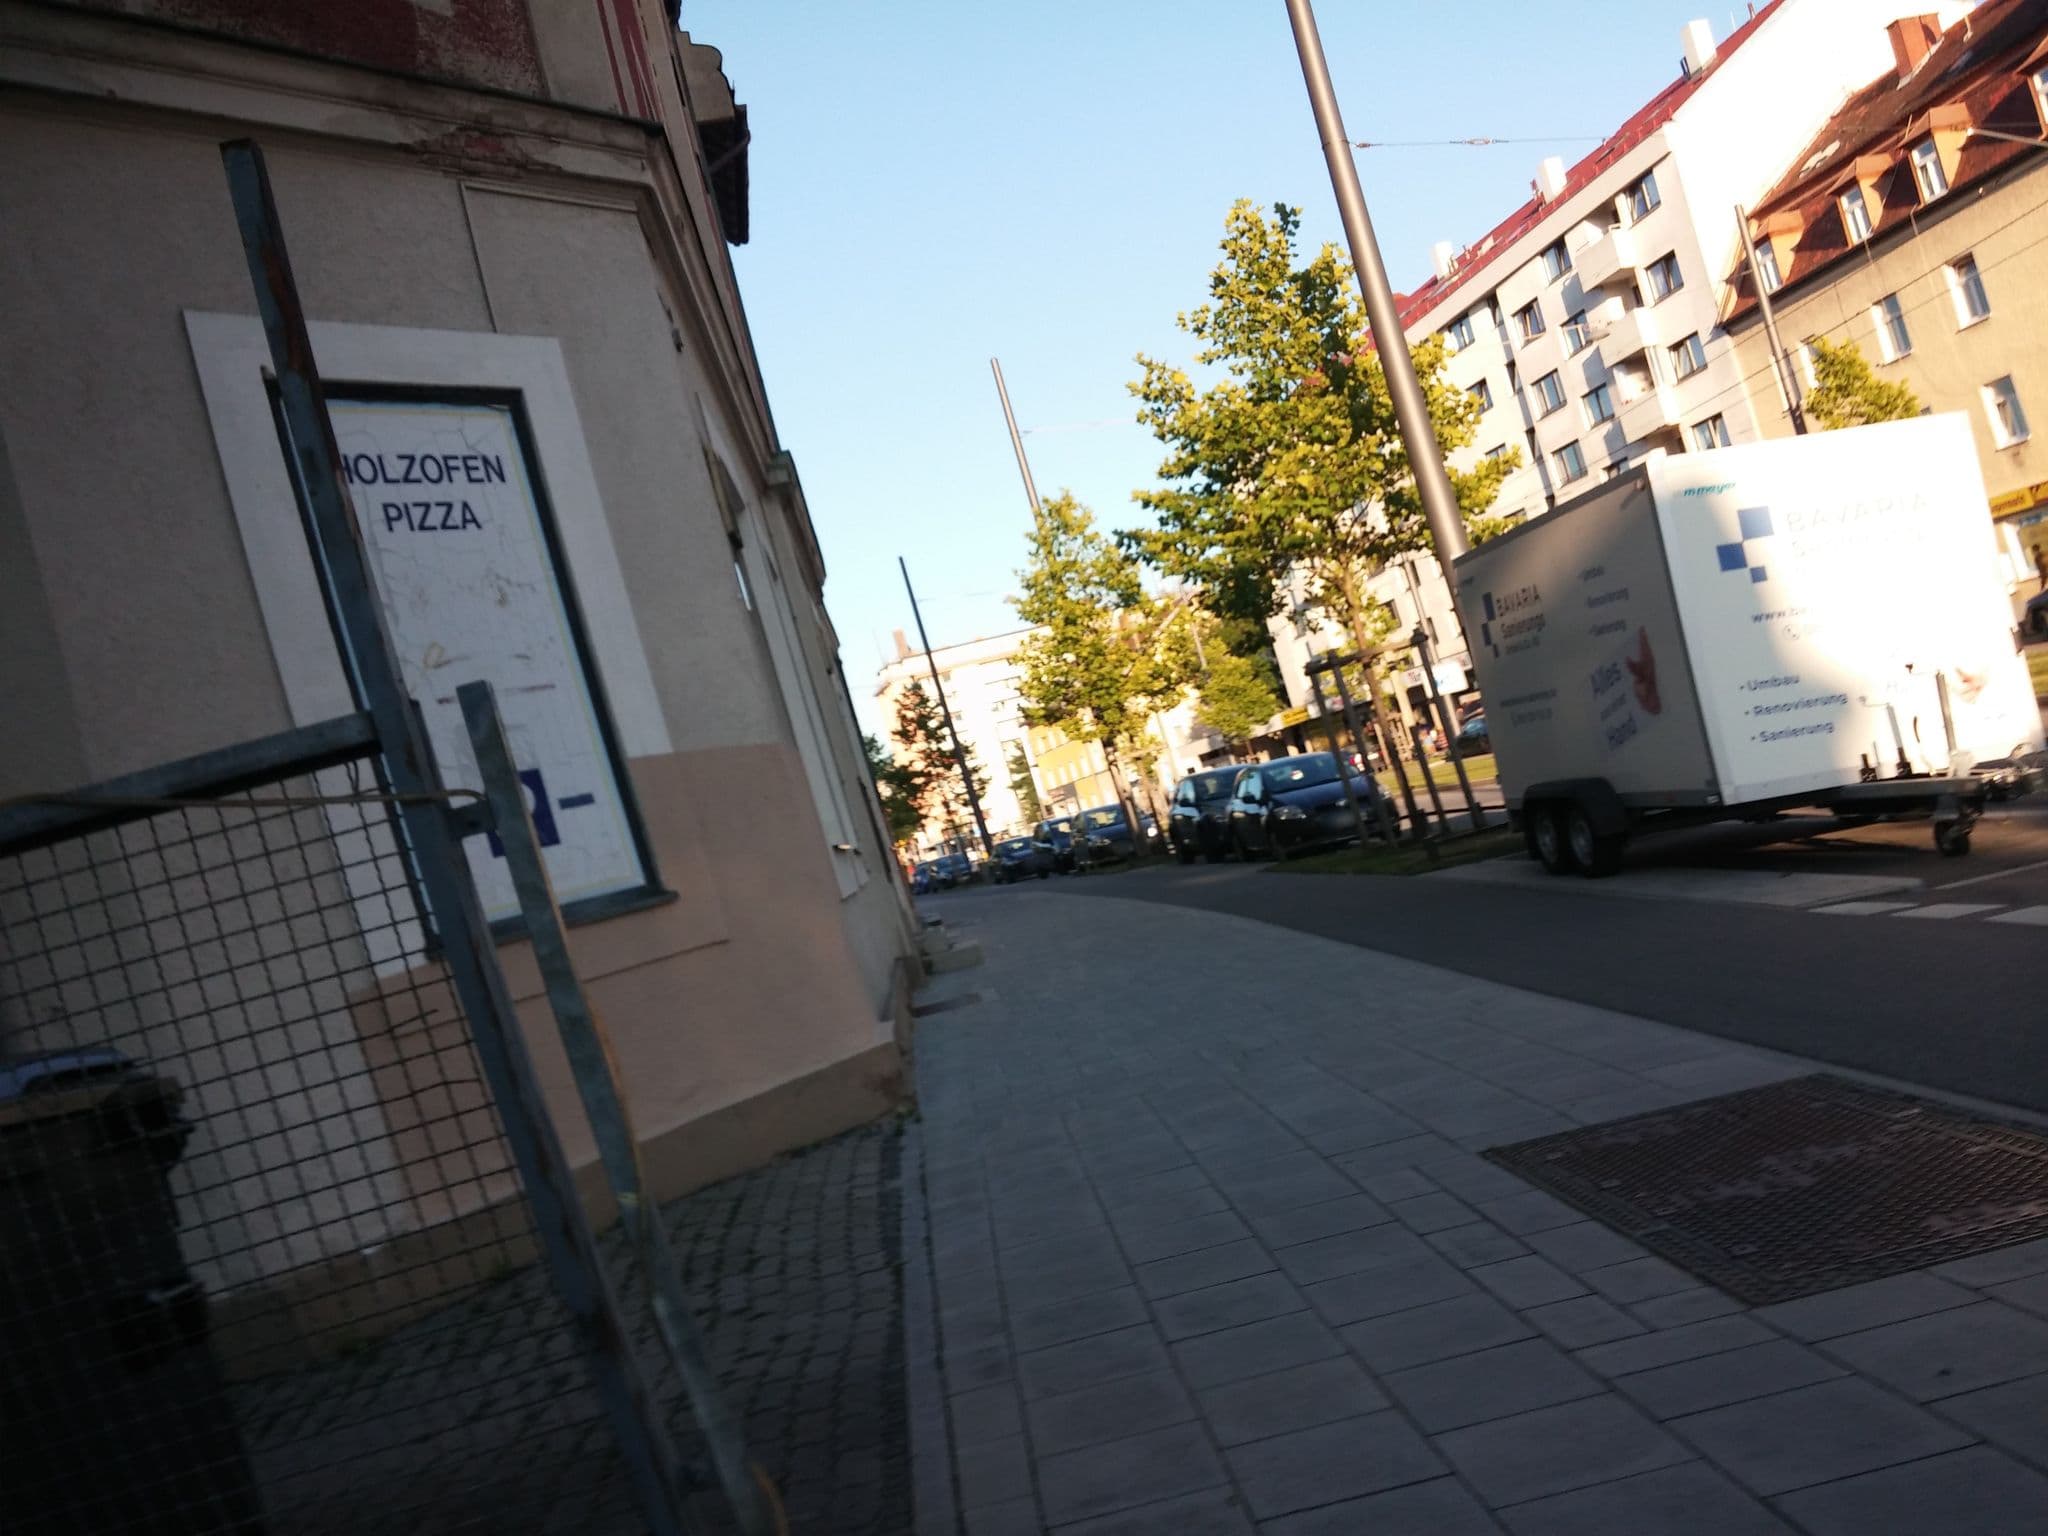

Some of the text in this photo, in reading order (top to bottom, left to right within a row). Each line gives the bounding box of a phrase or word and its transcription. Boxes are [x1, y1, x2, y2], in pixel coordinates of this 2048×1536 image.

[341, 453, 506, 485] HOLZOFEN
[382, 501, 483, 532] PIZZA
[1496, 584, 1541, 617] BAVARIA
[1747, 675, 1800, 691] Umbau
[1753, 693, 1848, 716] Renovierung
[1760, 722, 1834, 742] Sanierung
